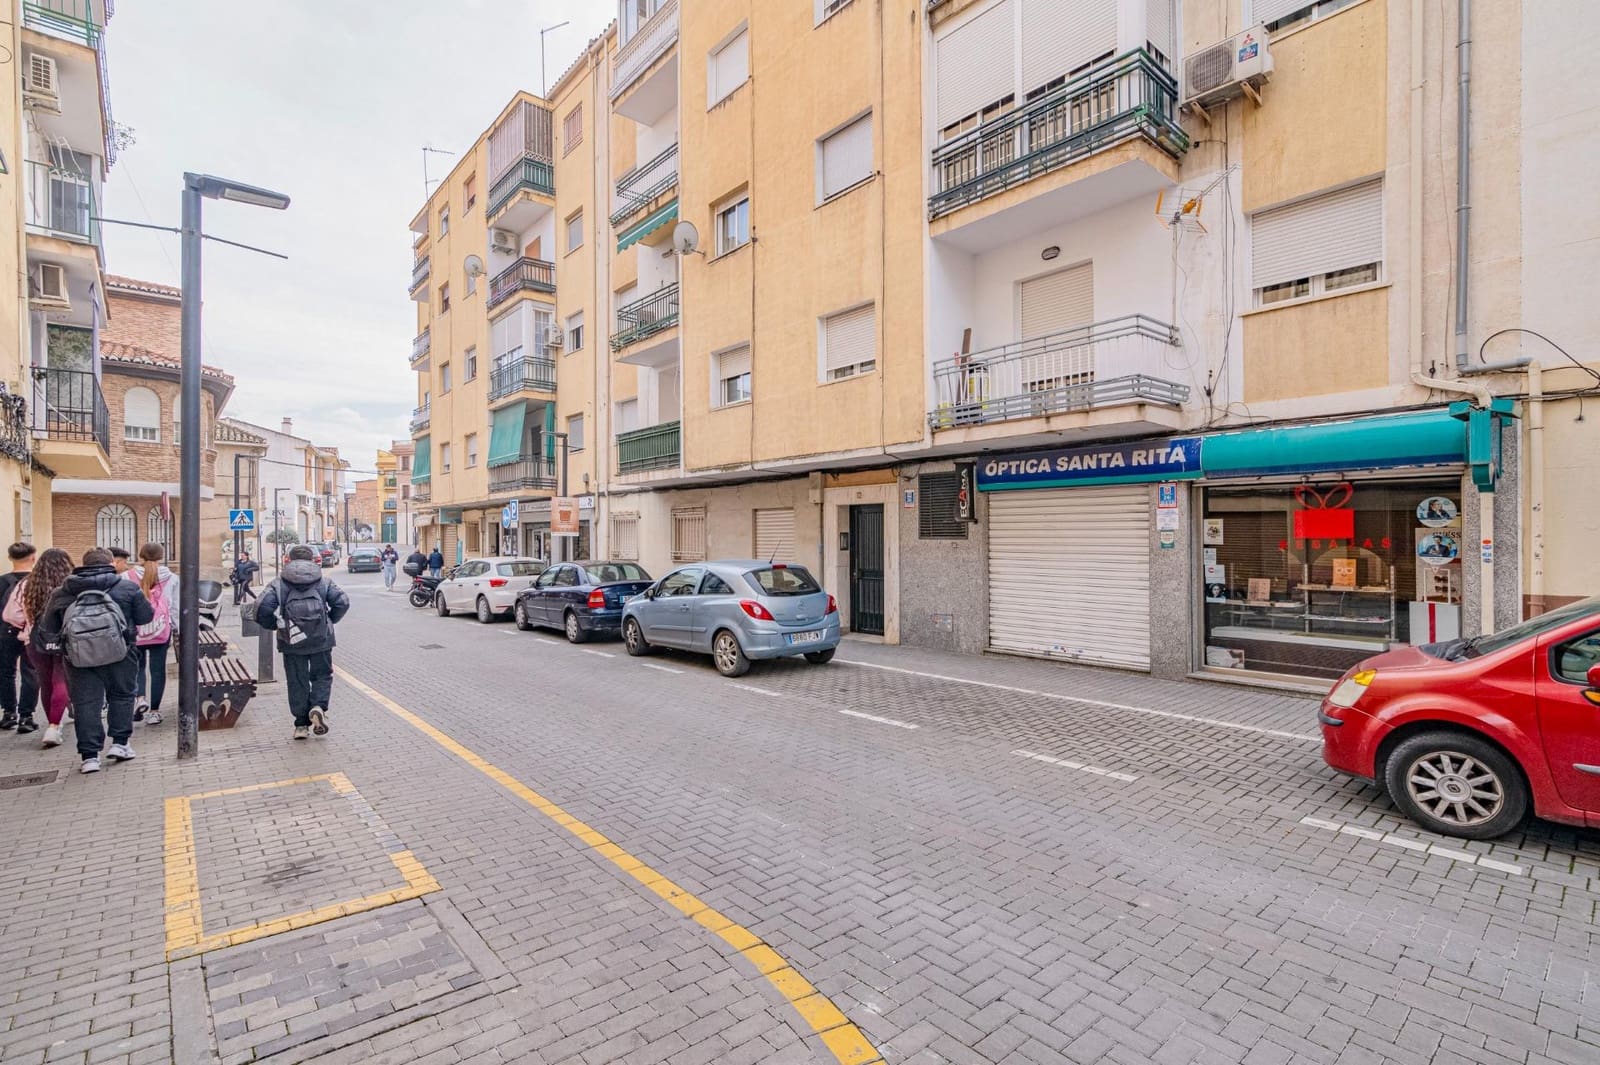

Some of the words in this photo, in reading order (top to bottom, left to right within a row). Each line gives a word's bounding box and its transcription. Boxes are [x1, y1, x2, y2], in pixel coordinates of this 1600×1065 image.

[985, 458, 1051, 477] ÓPTICA
[1056, 451, 1126, 472] SANTA
[1131, 445, 1187, 466] RITA
